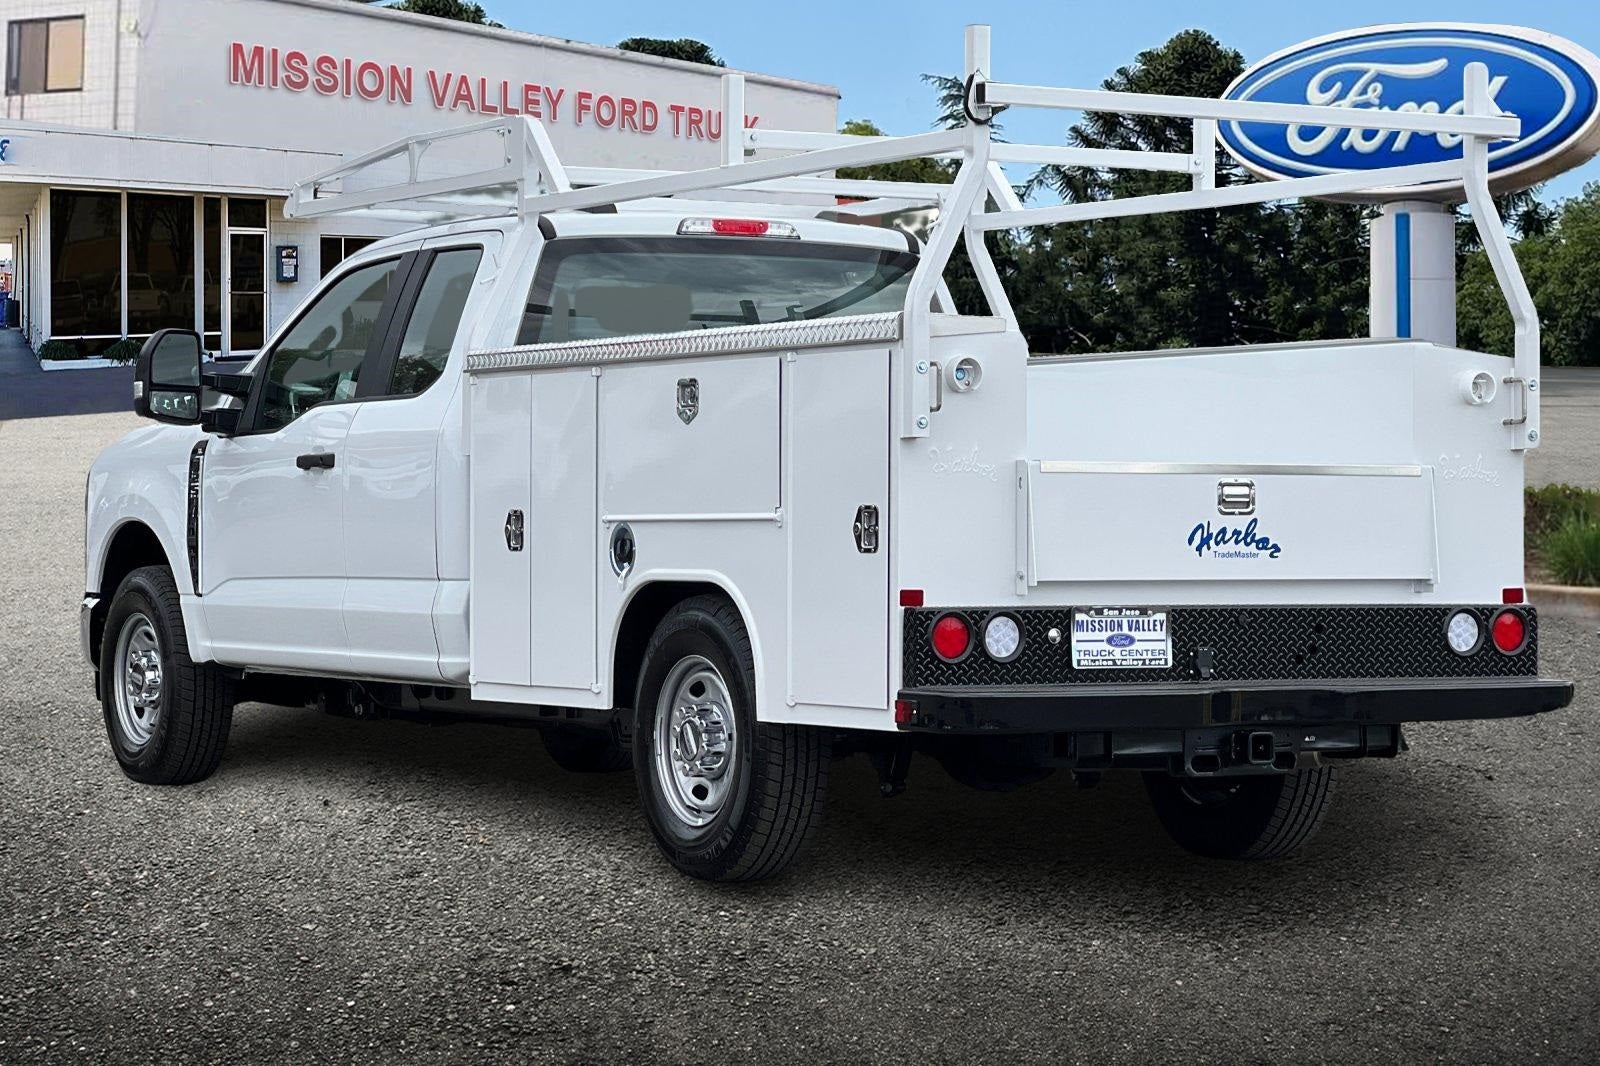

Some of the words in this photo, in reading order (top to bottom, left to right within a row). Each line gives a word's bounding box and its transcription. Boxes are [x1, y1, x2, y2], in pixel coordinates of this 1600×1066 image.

[230, 41, 413, 105] MISSION
[427, 69, 564, 122] VALLEY
[575, 90, 659, 134] FORD
[669, 104, 759, 141] TRU
[1187, 517, 1282, 559] Harbor
[1212, 550, 1261, 559] TradeMaster
[1103, 608, 1119, 616] San
[1075, 619, 1123, 632] MISSION
[1127, 619, 1165, 632] VALLEY
[1111, 636, 1130, 645] Ford
[1077, 649, 1115, 658] TRUCK
[1120, 649, 1166, 657] CENTER
[1115, 659, 1143, 667] Valley
